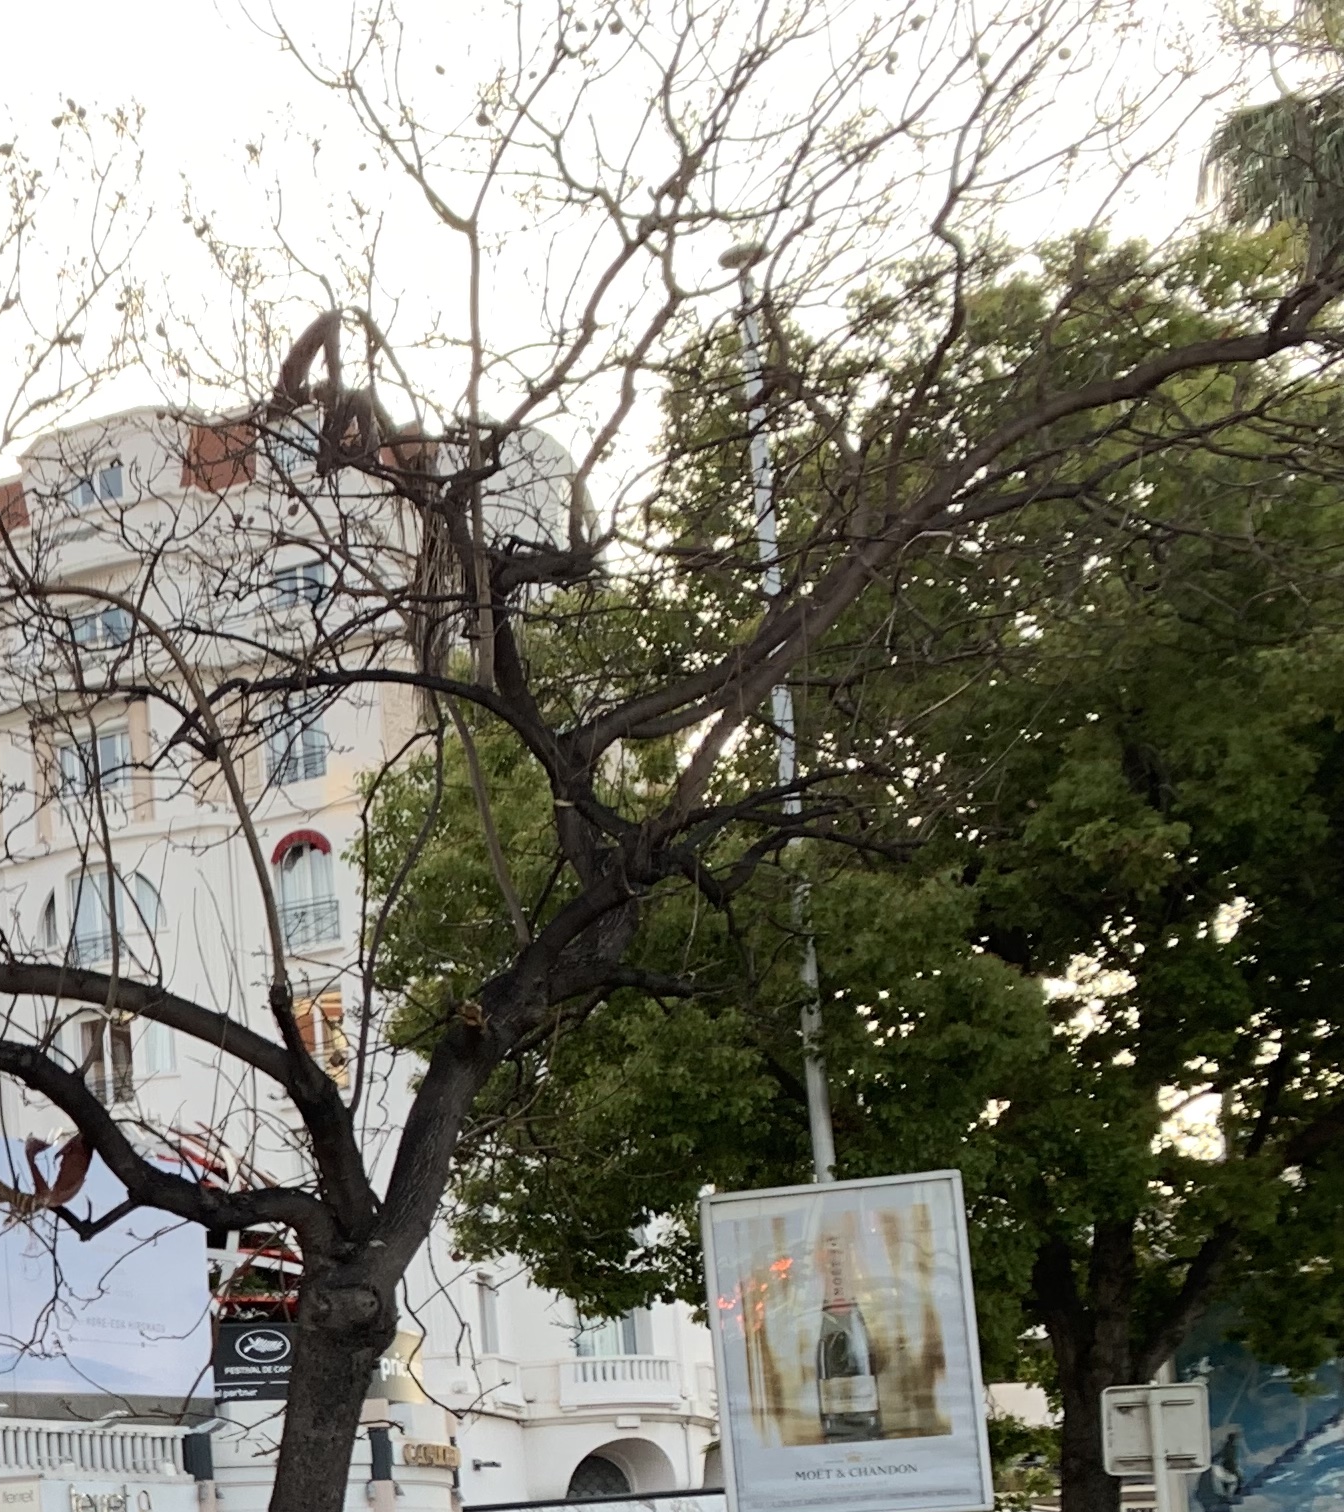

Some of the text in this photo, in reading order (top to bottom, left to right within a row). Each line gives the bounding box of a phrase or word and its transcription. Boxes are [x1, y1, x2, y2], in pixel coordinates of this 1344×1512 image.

[224, 1366, 261, 1375] FESTIVAL
[262, 1365, 273, 1373] DE
[223, 1388, 258, 1399] partner
[849, 1463, 918, 1478] CHANDON
